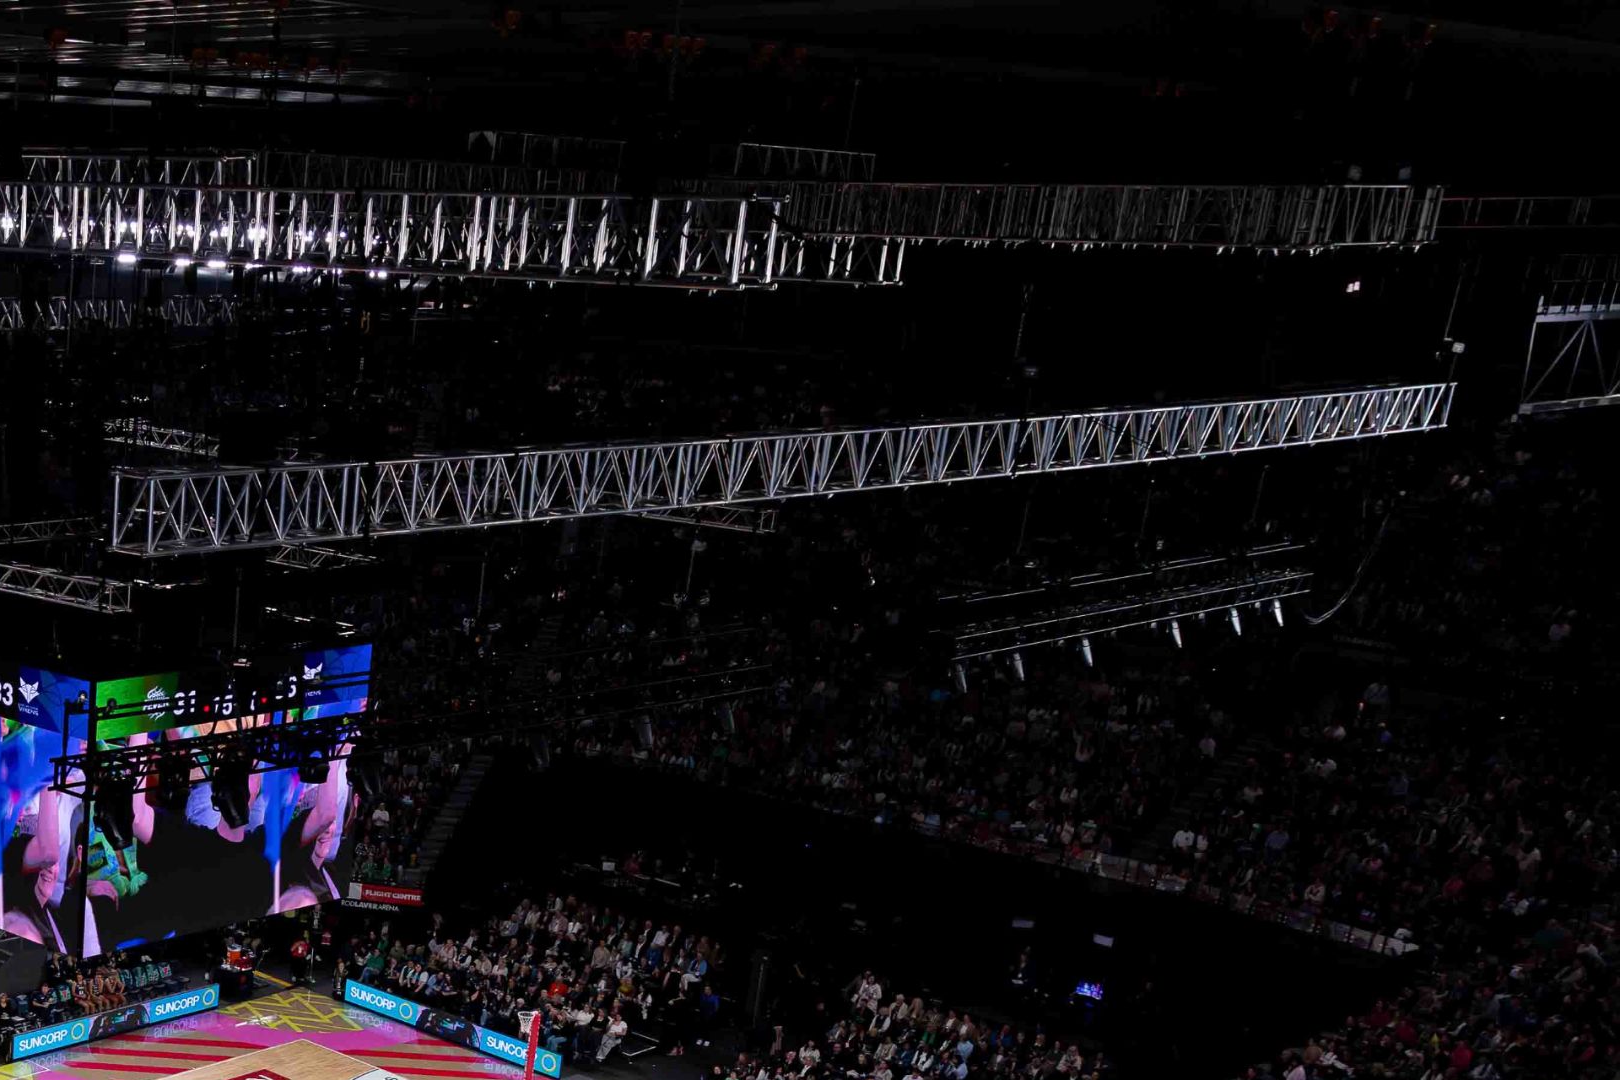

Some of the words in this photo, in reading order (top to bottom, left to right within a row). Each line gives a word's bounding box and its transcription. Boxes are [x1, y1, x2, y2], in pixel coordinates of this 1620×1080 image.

[155, 996, 200, 1016] SUNCORP
[350, 987, 396, 1011] SUNCORP
[19, 1029, 68, 1052] SUNCORP
